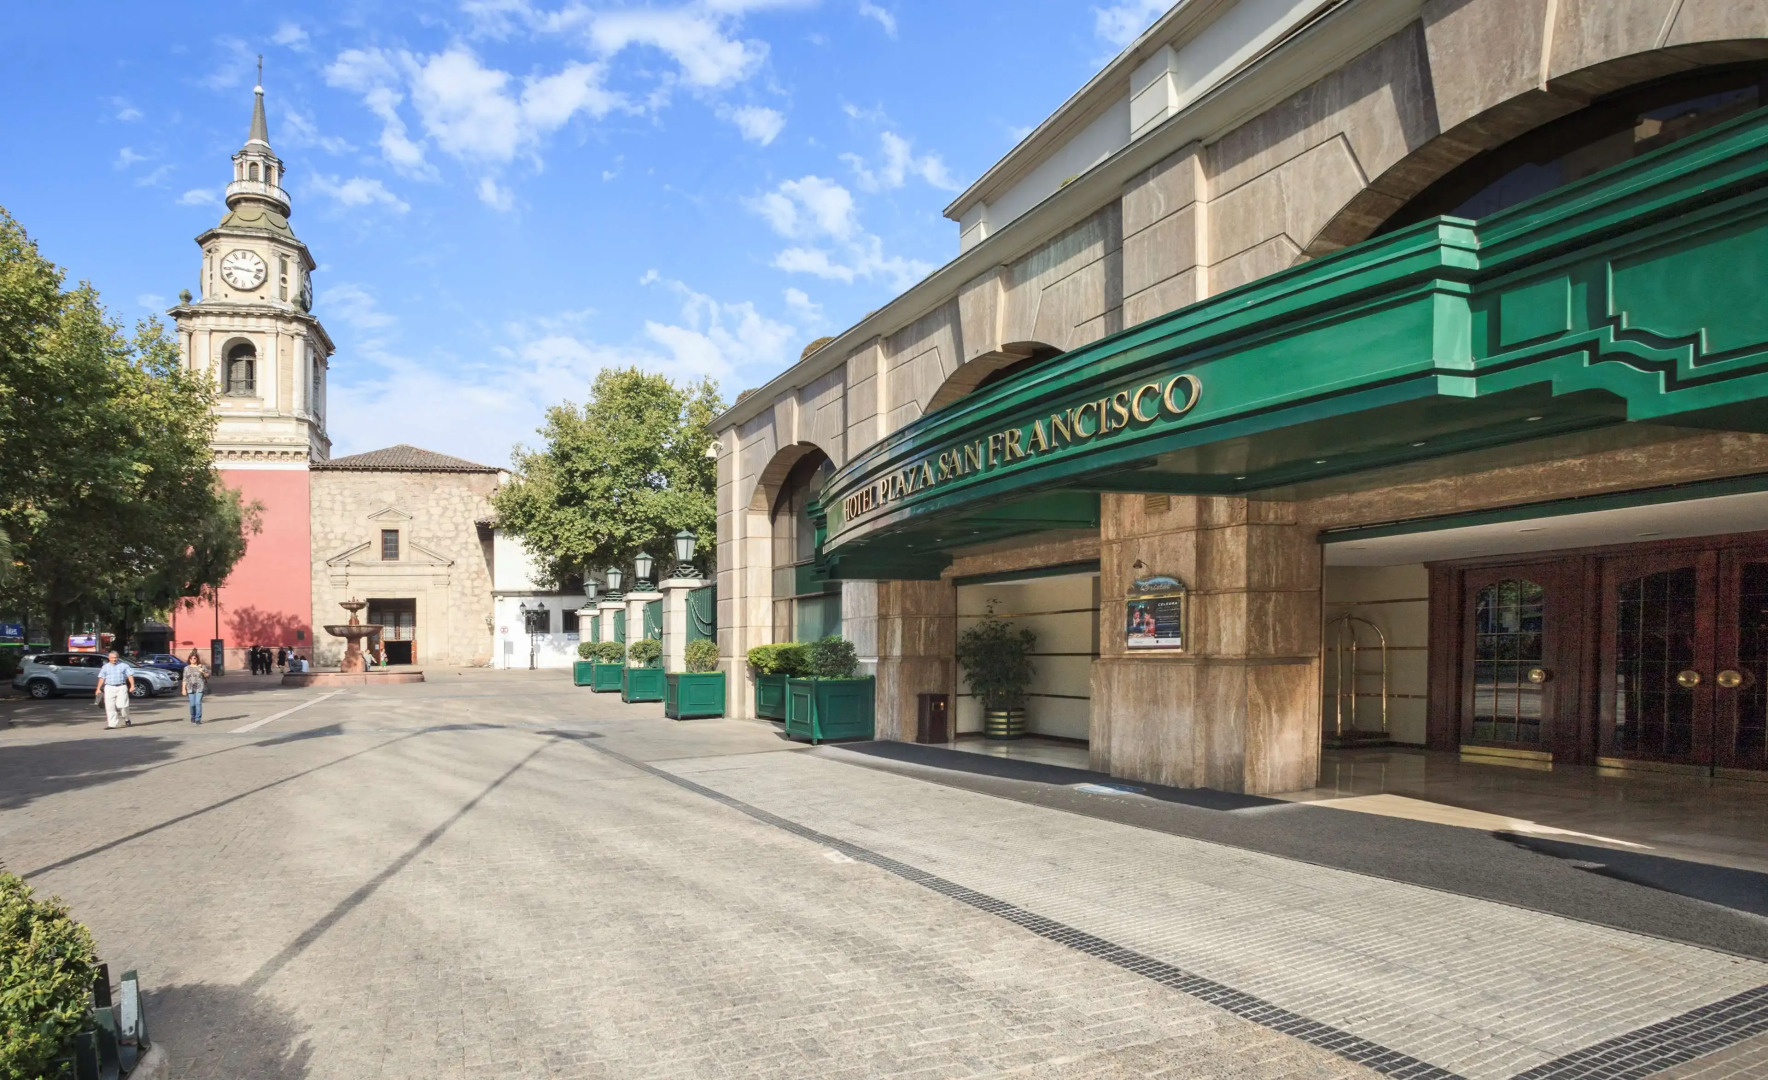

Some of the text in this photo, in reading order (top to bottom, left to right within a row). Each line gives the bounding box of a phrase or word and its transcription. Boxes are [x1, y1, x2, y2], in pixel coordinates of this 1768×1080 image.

[845, 373, 1203, 521] HOTEL PLAZA SAN FRANCISCO
